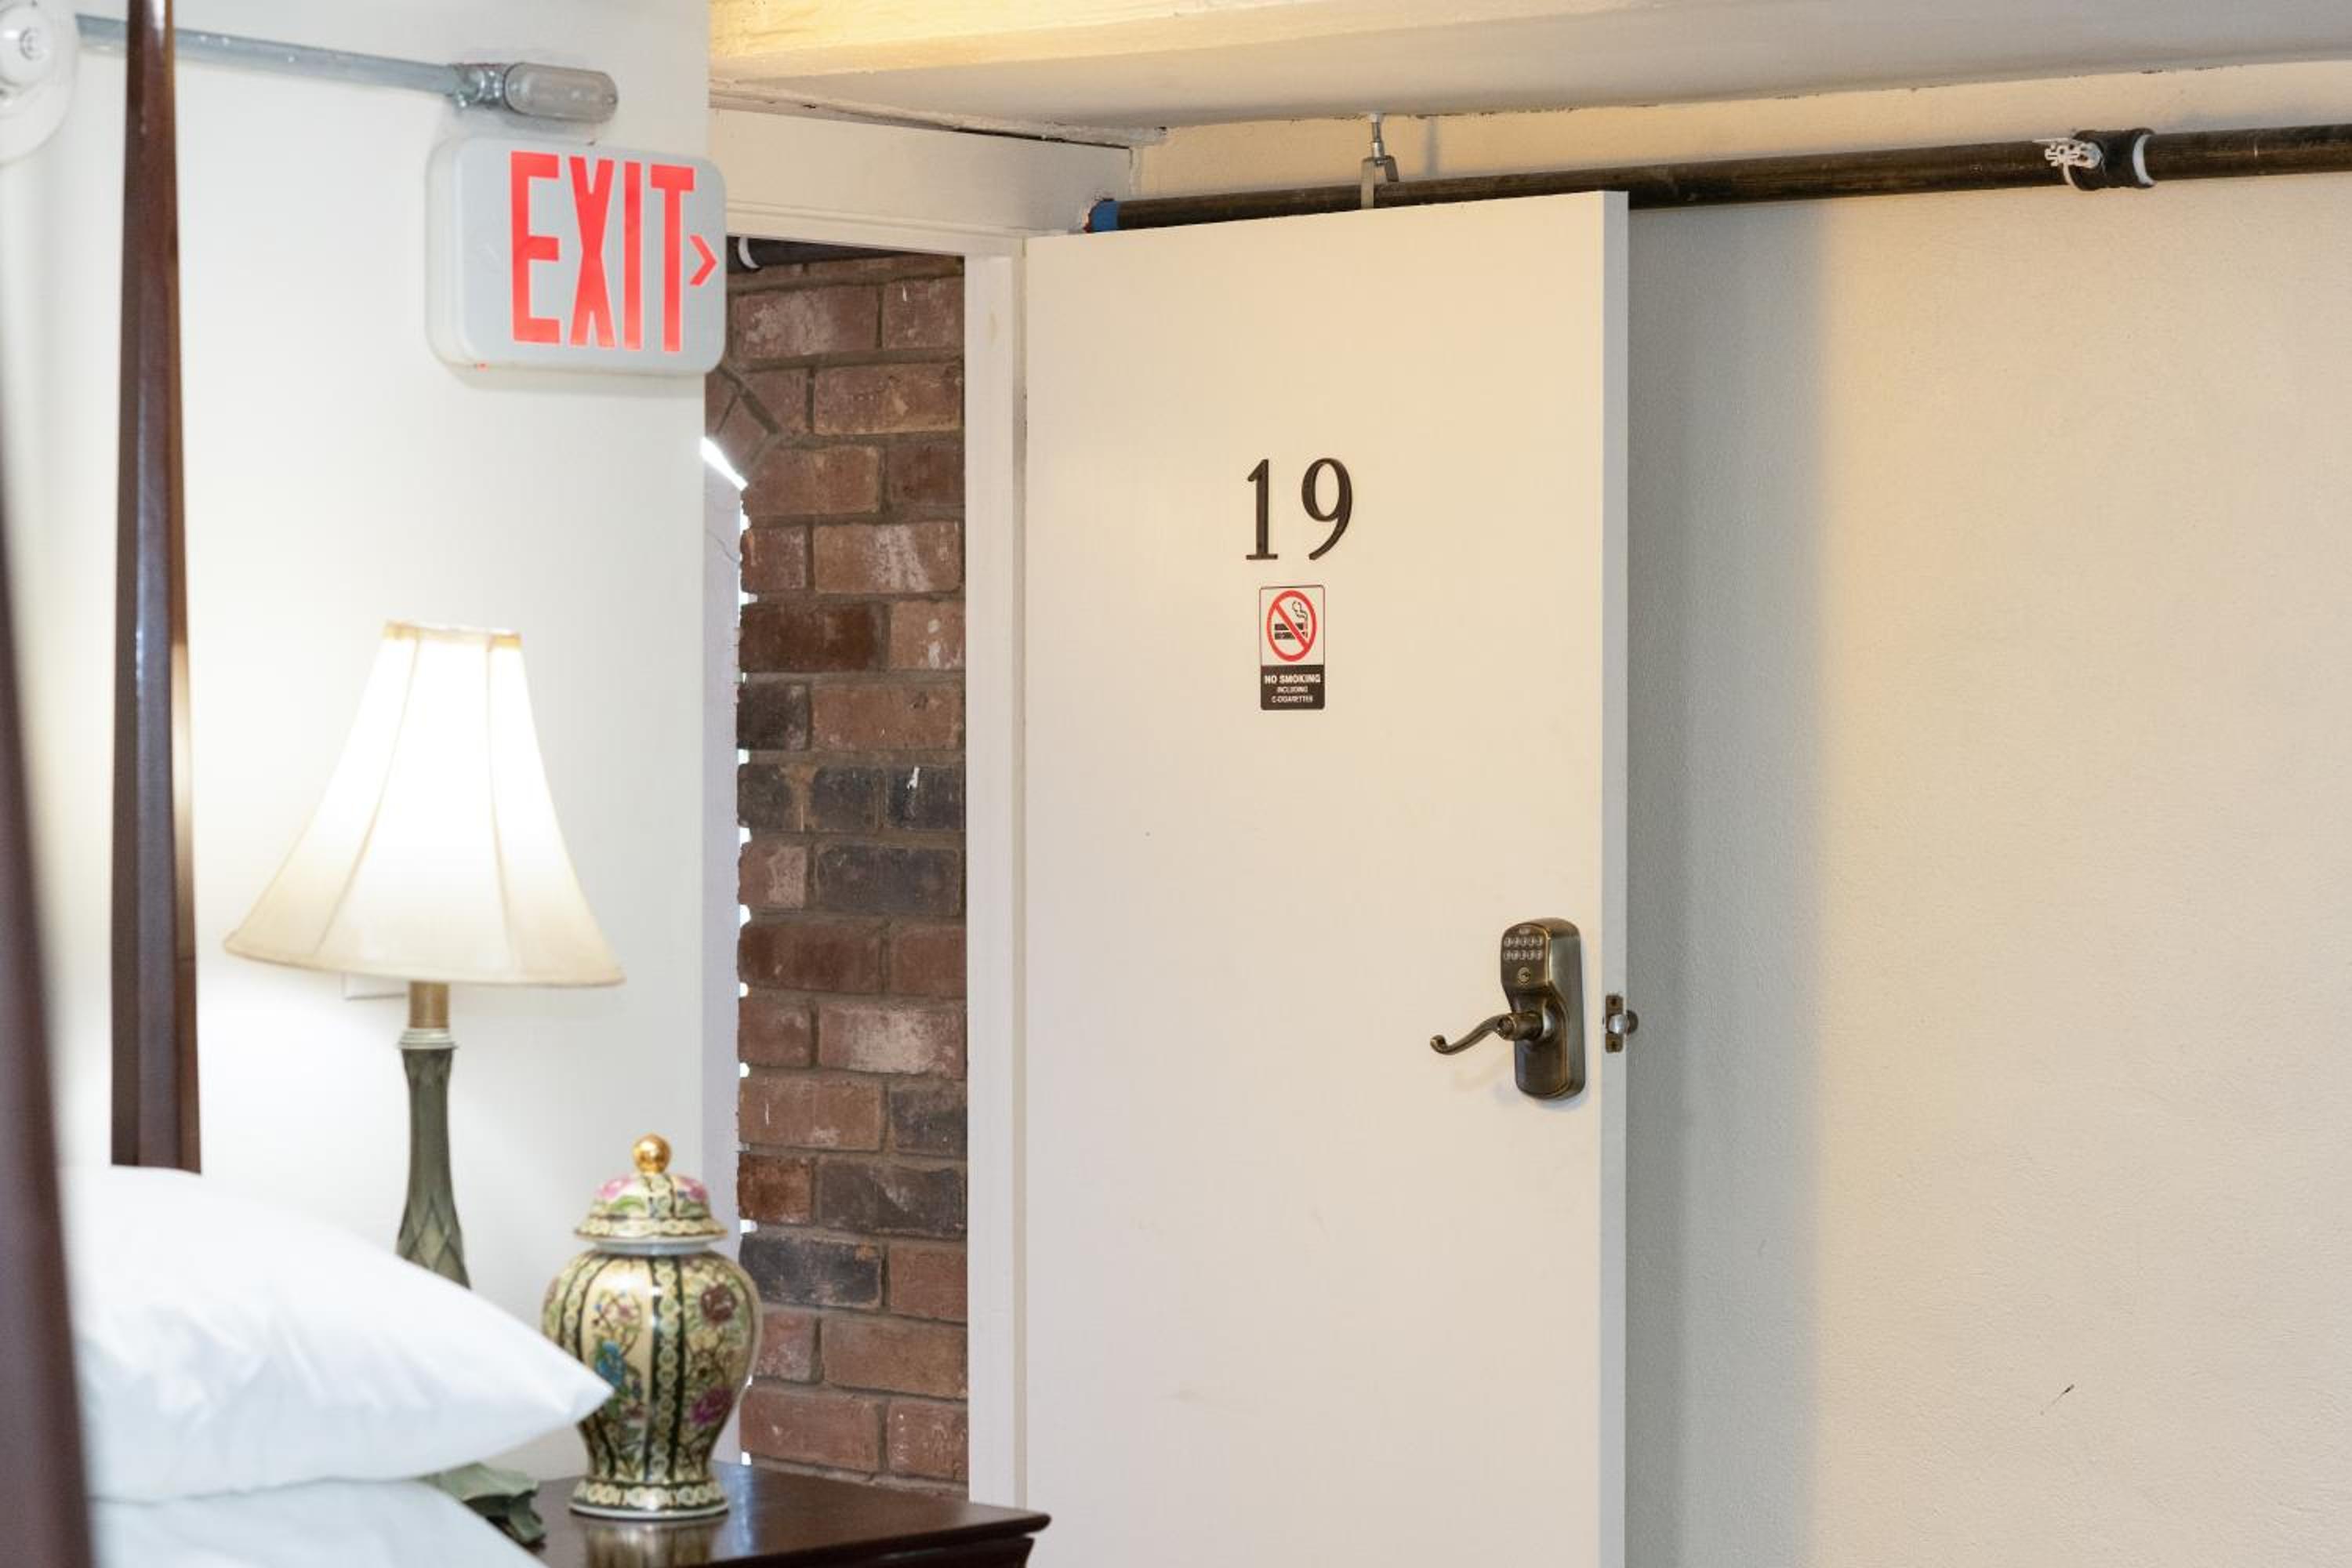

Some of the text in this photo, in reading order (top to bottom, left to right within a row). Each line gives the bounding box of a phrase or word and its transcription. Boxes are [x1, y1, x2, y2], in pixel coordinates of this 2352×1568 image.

[510, 151, 695, 352] EXIT
[1246, 458, 1352, 560] 19
[1264, 674, 1321, 684] NO SMOKING
